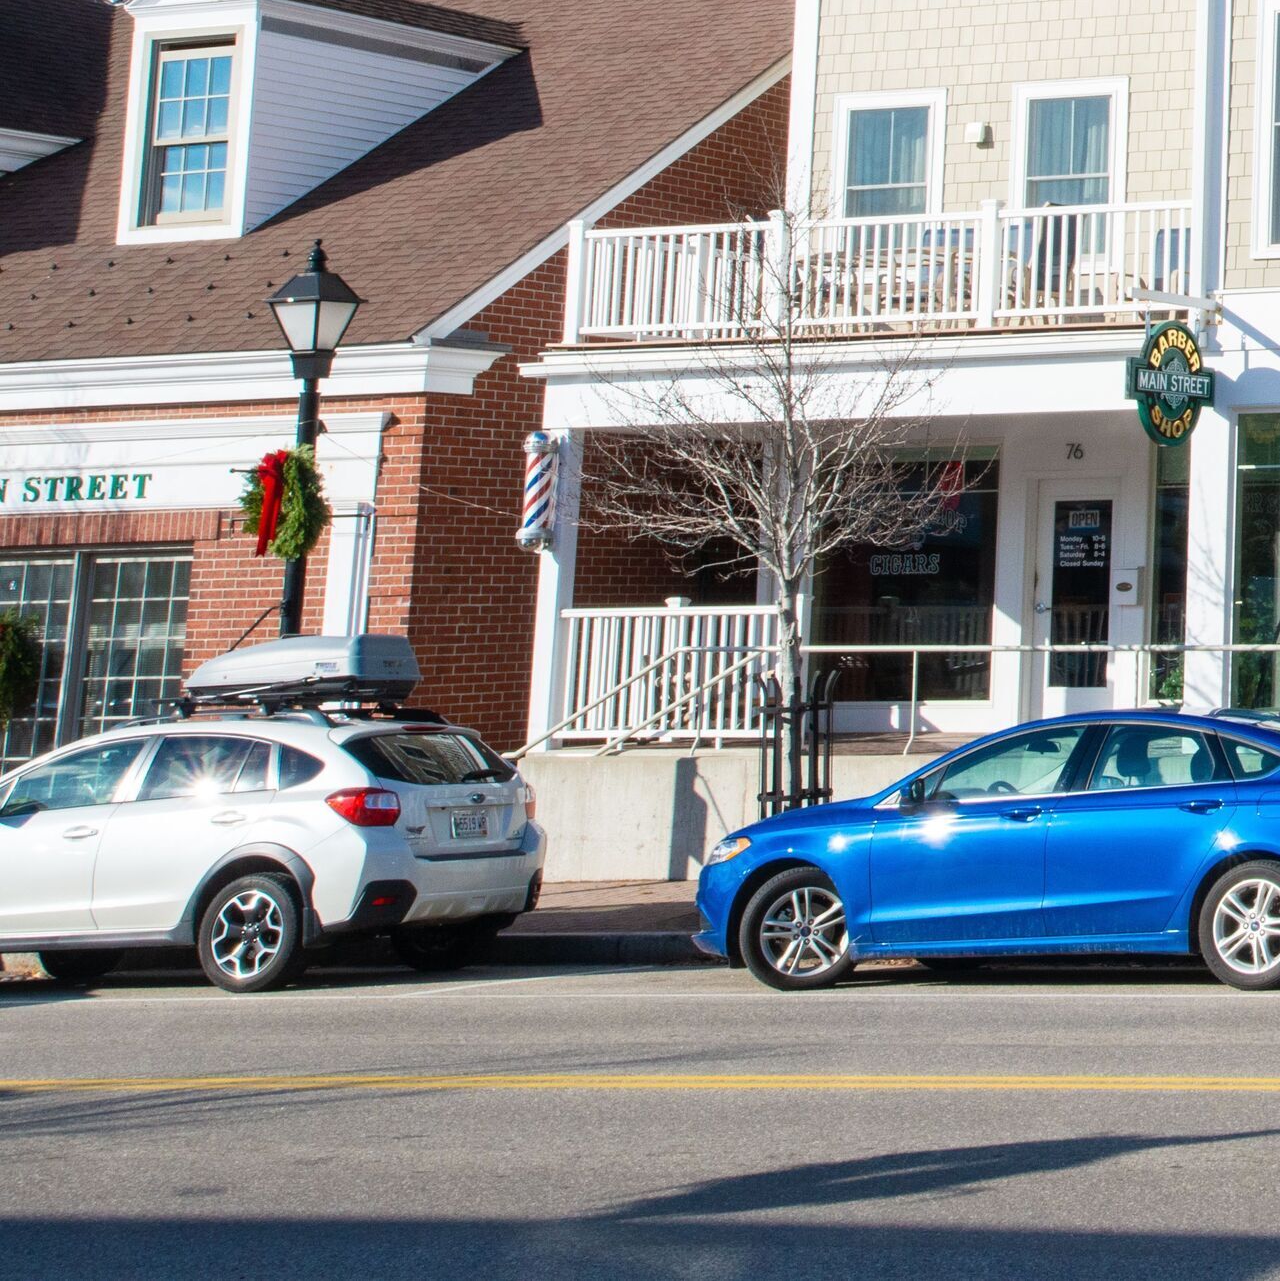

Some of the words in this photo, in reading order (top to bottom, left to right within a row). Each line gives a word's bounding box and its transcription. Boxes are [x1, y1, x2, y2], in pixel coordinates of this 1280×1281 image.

[1150, 328, 1201, 372] BARBER
[1139, 371, 1168, 391] MAIN
[1170, 375, 1210, 395] STREET
[1151, 405, 1193, 438] SHOP
[1066, 443, 1084, 459] 76
[22, 473, 152, 503] STREET
[1072, 511, 1098, 526] OPEN
[1060, 535, 1083, 543] Monday
[869, 553, 941, 575] CIGARS
